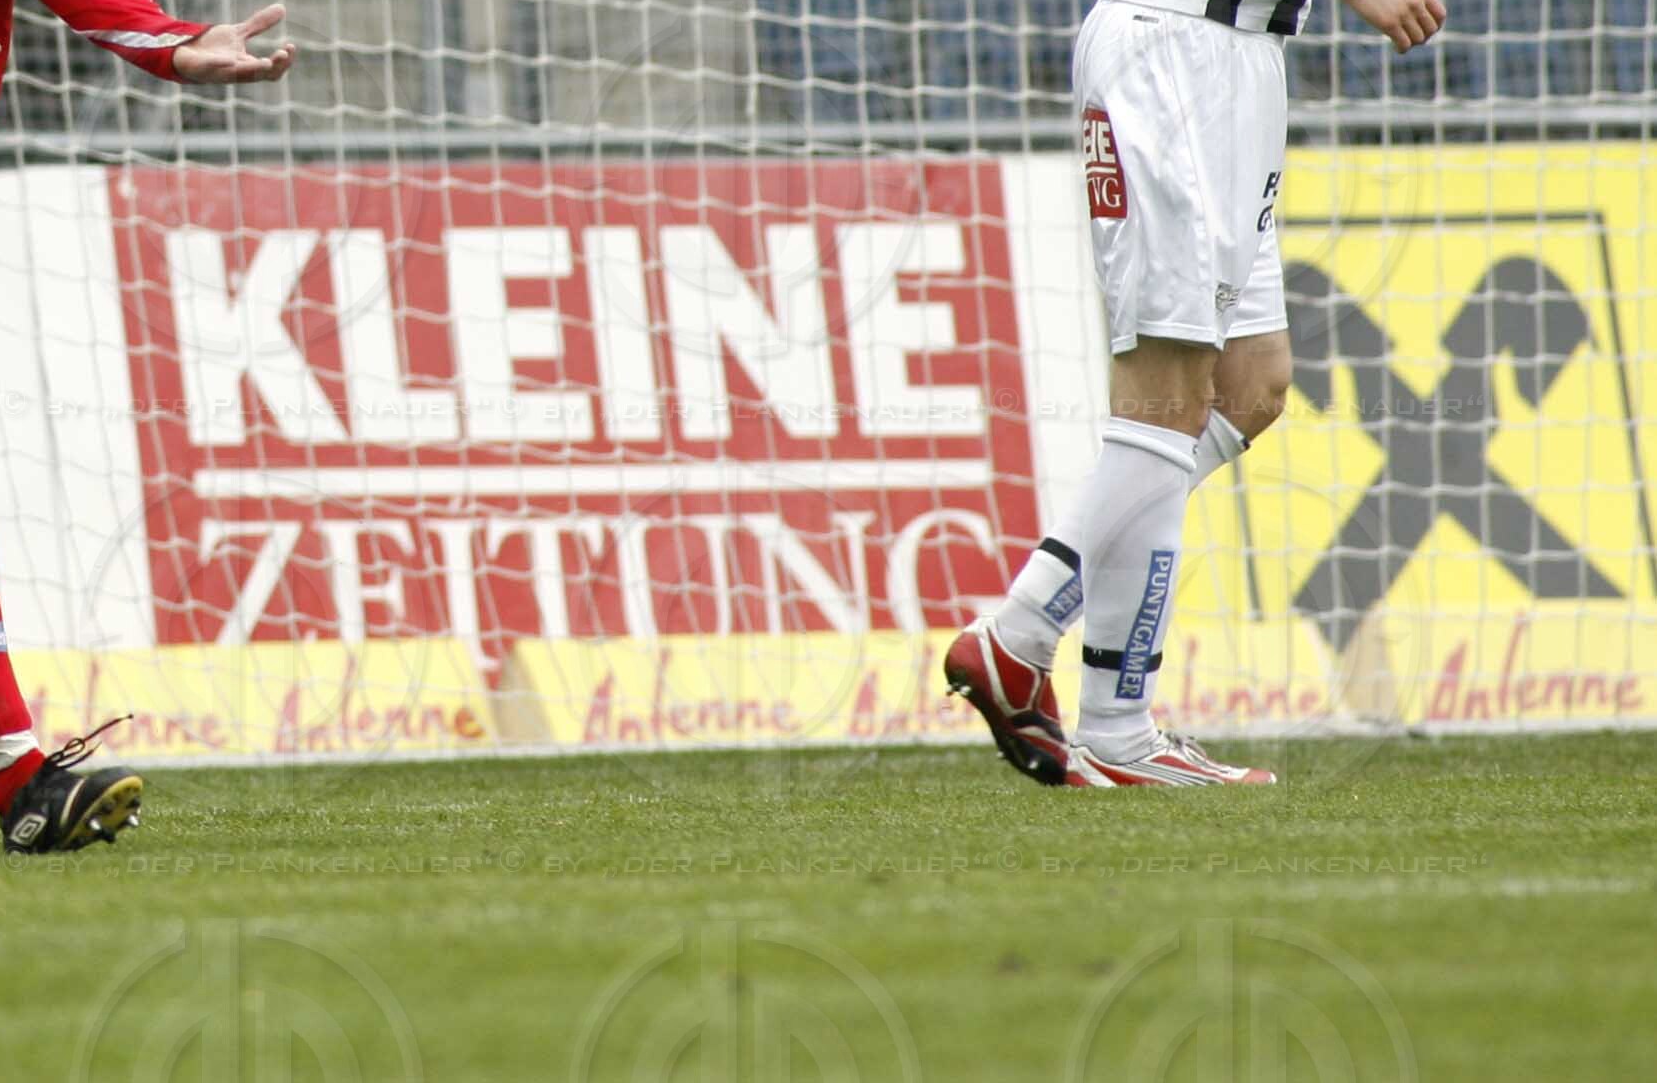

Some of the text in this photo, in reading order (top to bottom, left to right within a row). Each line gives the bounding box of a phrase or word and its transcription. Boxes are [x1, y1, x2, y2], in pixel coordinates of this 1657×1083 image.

[166, 221, 990, 447] KLEINE
[199, 508, 1005, 656] ZEITUNG
[1121, 555, 1172, 696] PUNTIGAMER
[1426, 610, 1644, 720] Antenne
